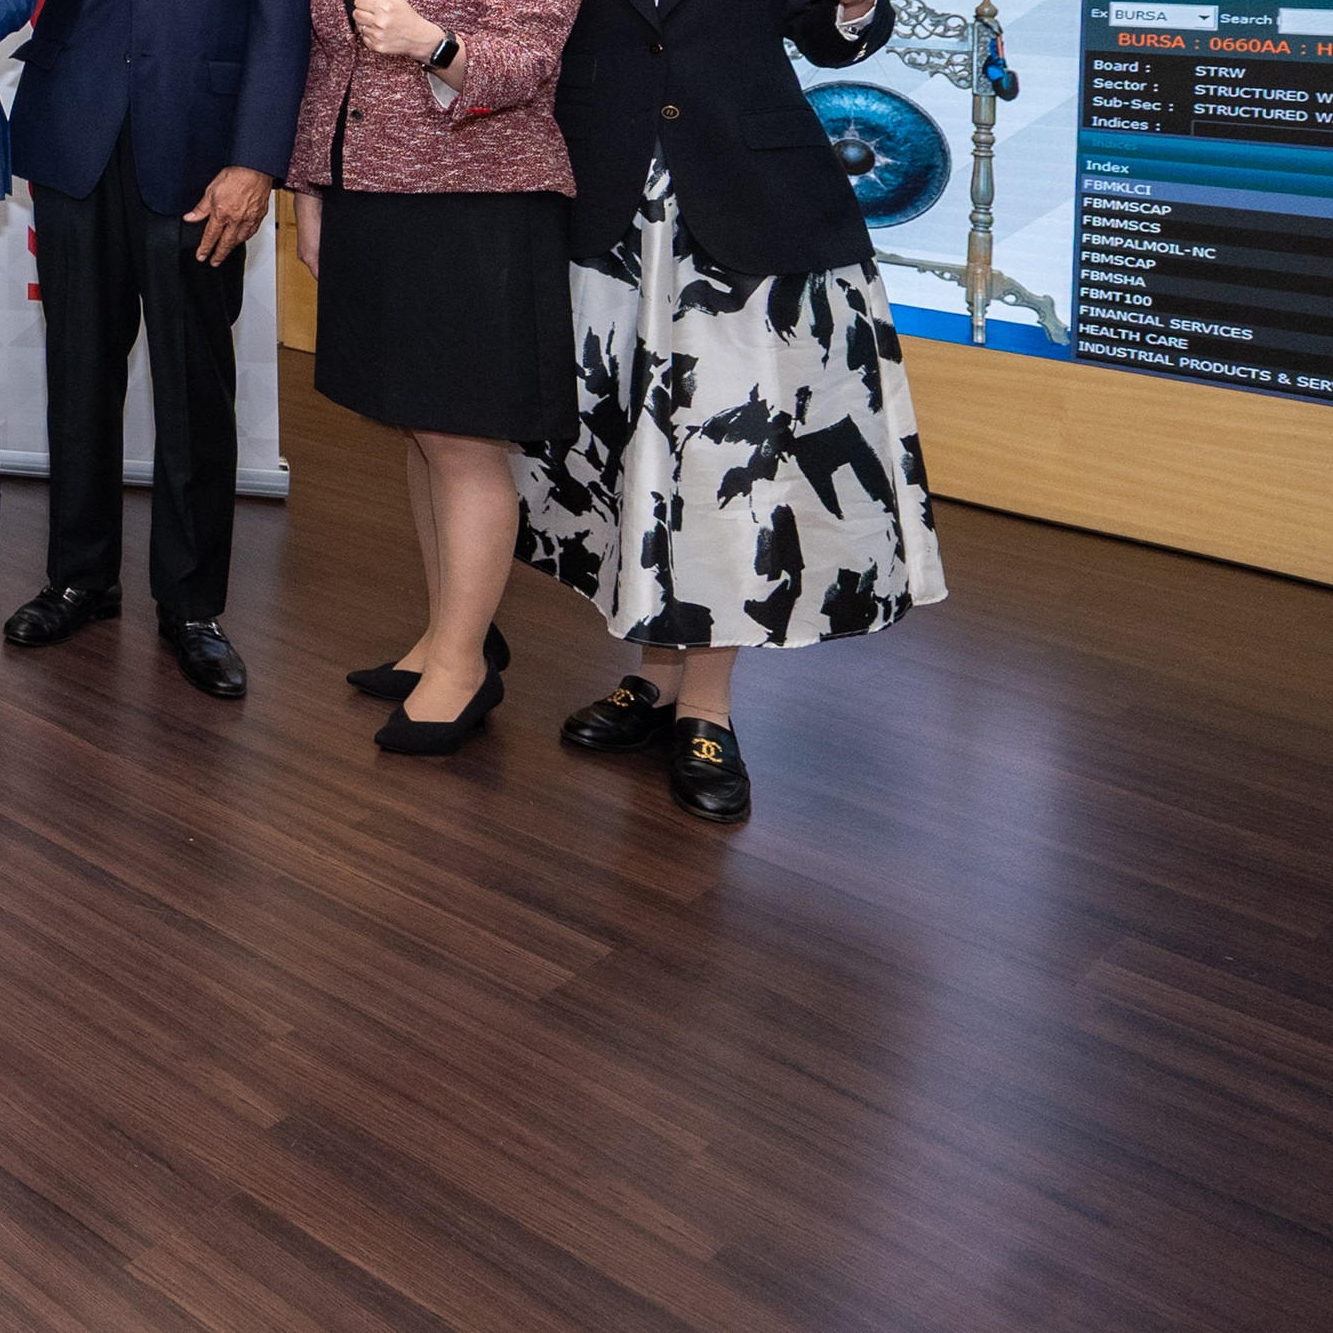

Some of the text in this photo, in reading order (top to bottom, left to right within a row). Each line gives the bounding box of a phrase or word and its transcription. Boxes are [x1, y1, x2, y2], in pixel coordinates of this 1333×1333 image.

[1091, 8, 1273, 26] Ex BURSA Search
[1117, 32, 1186, 50] BURSA
[1209, 37, 1291, 55] 0660AA
[1093, 59, 1139, 73] Board
[1194, 65, 1247, 79] STRW
[1092, 78, 1148, 92] Sector
[1194, 84, 1310, 103] STRUCTURED
[1092, 96, 1162, 112] Sub-Sec
[1193, 103, 1309, 122] STRUCTURED
[1091, 116, 1149, 131] Indices
[1086, 160, 1130, 174] Index
[1083, 178, 1152, 196] FBMKLCI
[1083, 197, 1172, 216] FBMMSCAP
[1082, 215, 1162, 234] FBMMSCS
[1081, 233, 1217, 260] FBMPALMOIL-NC
[1081, 251, 1156, 270] FBMSCAP
[1080, 269, 1146, 288] FBMSHA
[1079, 287, 1153, 307] FBMT100
[1079, 305, 1254, 341] FINANCIAL SERVICES
[1078, 323, 1190, 350] HEALTH CARE
[1078, 341, 1333, 392] INDUSTRIAL PRODUCTS & SER
